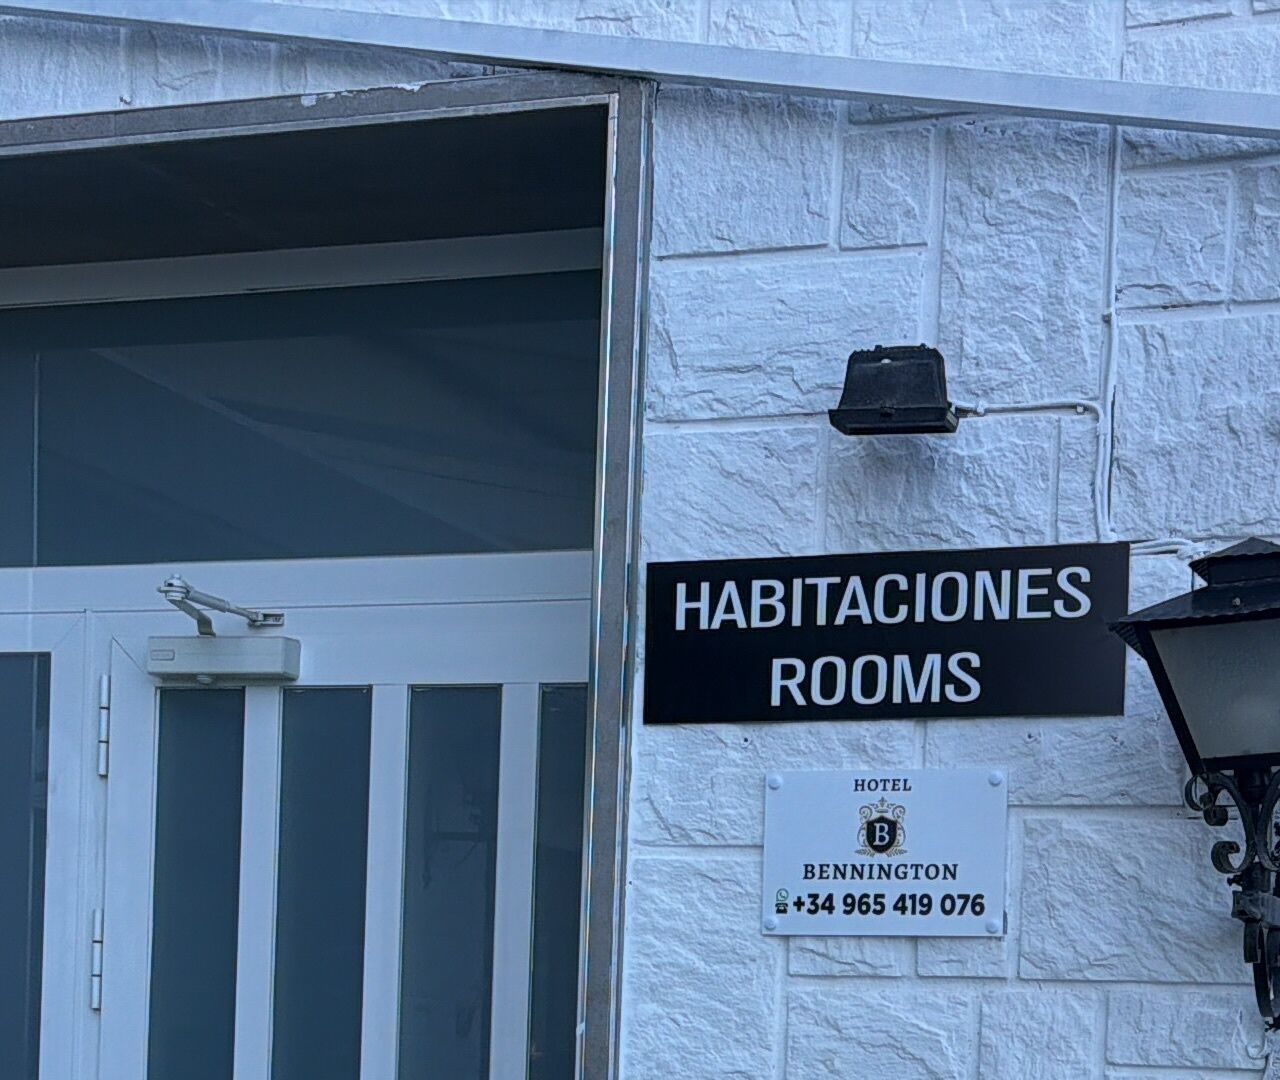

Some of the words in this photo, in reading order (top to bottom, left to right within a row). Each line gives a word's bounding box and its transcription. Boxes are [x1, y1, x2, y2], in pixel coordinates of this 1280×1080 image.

[675, 566, 1092, 631] HABITACIONES
[770, 651, 982, 707] ROOMS
[853, 778, 913, 793] HOTEL
[872, 822, 890, 847] B
[802, 863, 959, 881] BENNINGTON
[792, 892, 836, 916] +34
[842, 892, 886, 916] 965
[892, 892, 933, 916] 419
[940, 892, 986, 917] 076
